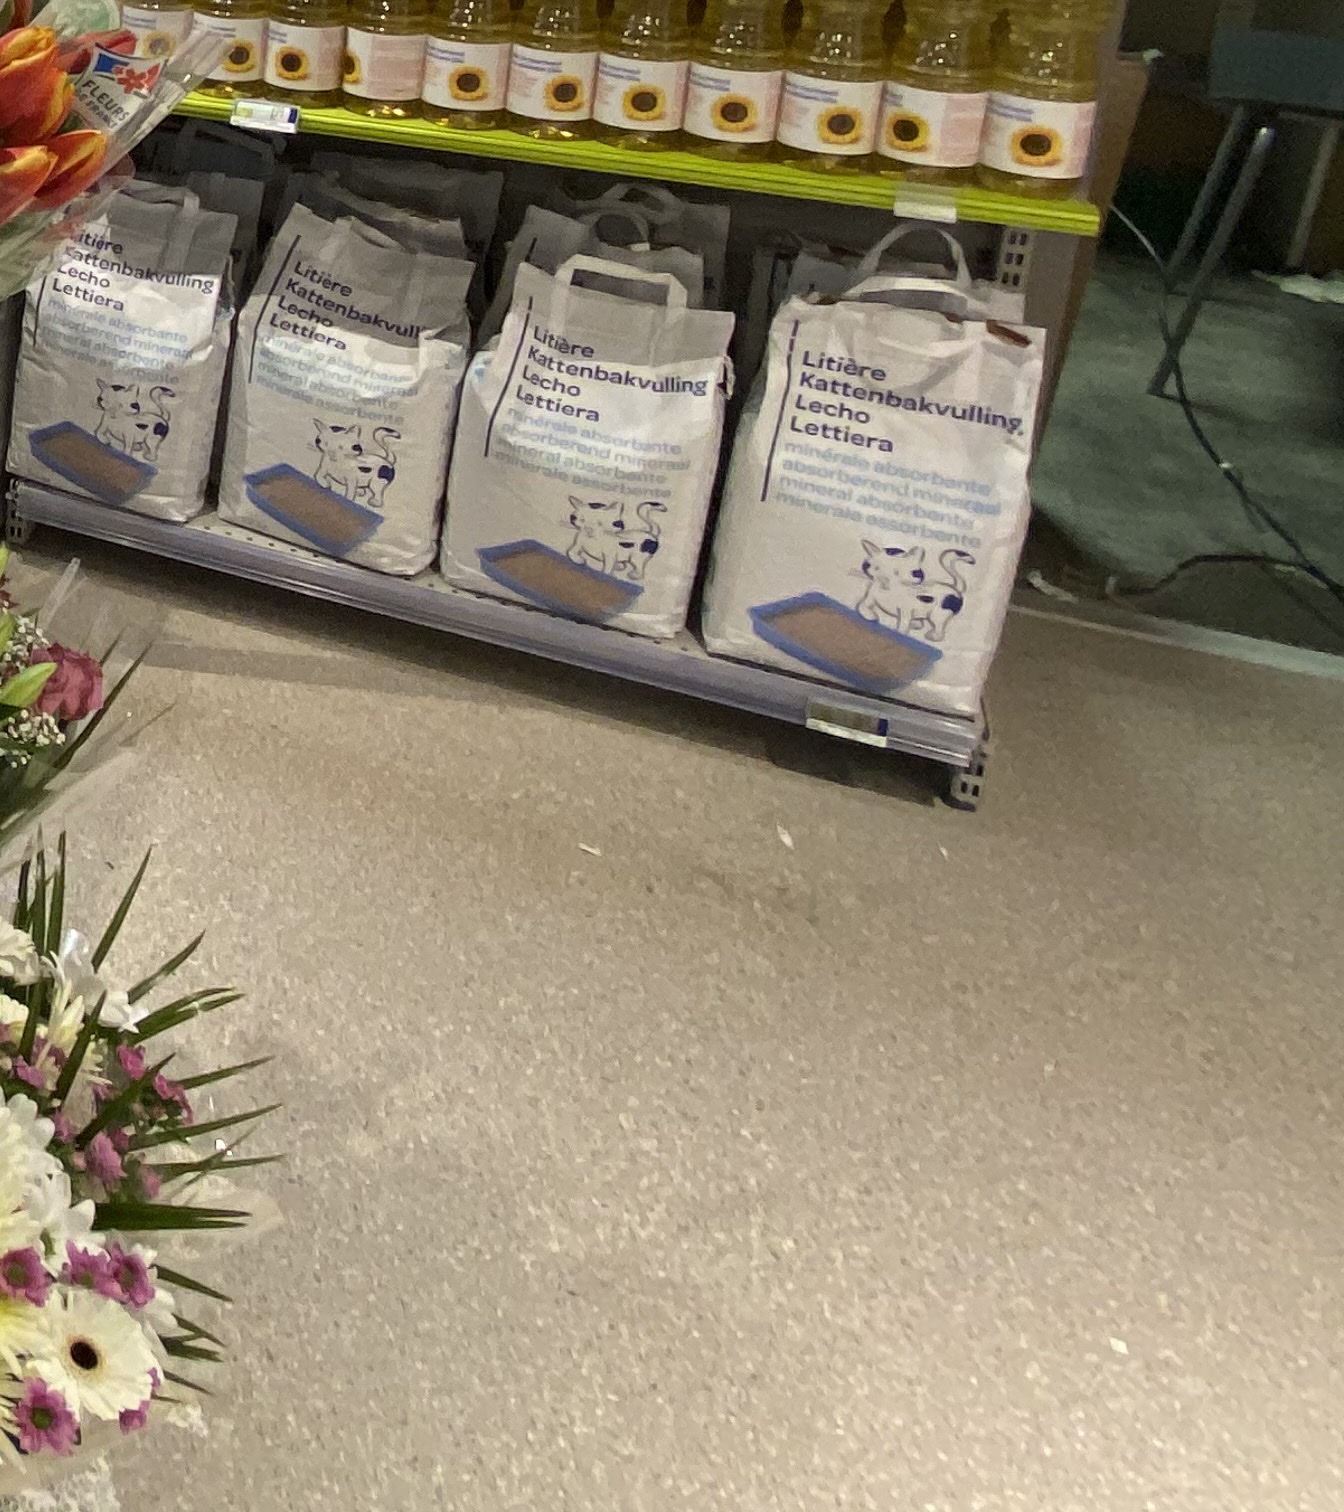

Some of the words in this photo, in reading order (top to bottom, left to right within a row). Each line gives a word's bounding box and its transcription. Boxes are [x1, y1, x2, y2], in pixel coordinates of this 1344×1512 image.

[81, 79, 130, 121] FLEURS
[77, 229, 123, 255] itière
[65, 245, 215, 295] Kattenbakvulling
[294, 261, 353, 297] Litière
[52, 277, 125, 312] Lettiera
[278, 295, 334, 328] Lecho
[285, 278, 422, 338] Kattenbakvull
[270, 313, 347, 351] Lettiera
[533, 325, 595, 358] Litière
[522, 365, 581, 397] Lecho
[528, 345, 708, 397] Kattenbakvulling
[802, 351, 886, 382] Litière
[516, 384, 600, 423] Lettiera
[795, 394, 871, 425] Lecho
[799, 371, 1022, 436] Kattenbakvulling
[580, 427, 682, 455] absorbante
[790, 414, 894, 454] Lettiera
[784, 442, 870, 471] minérale
